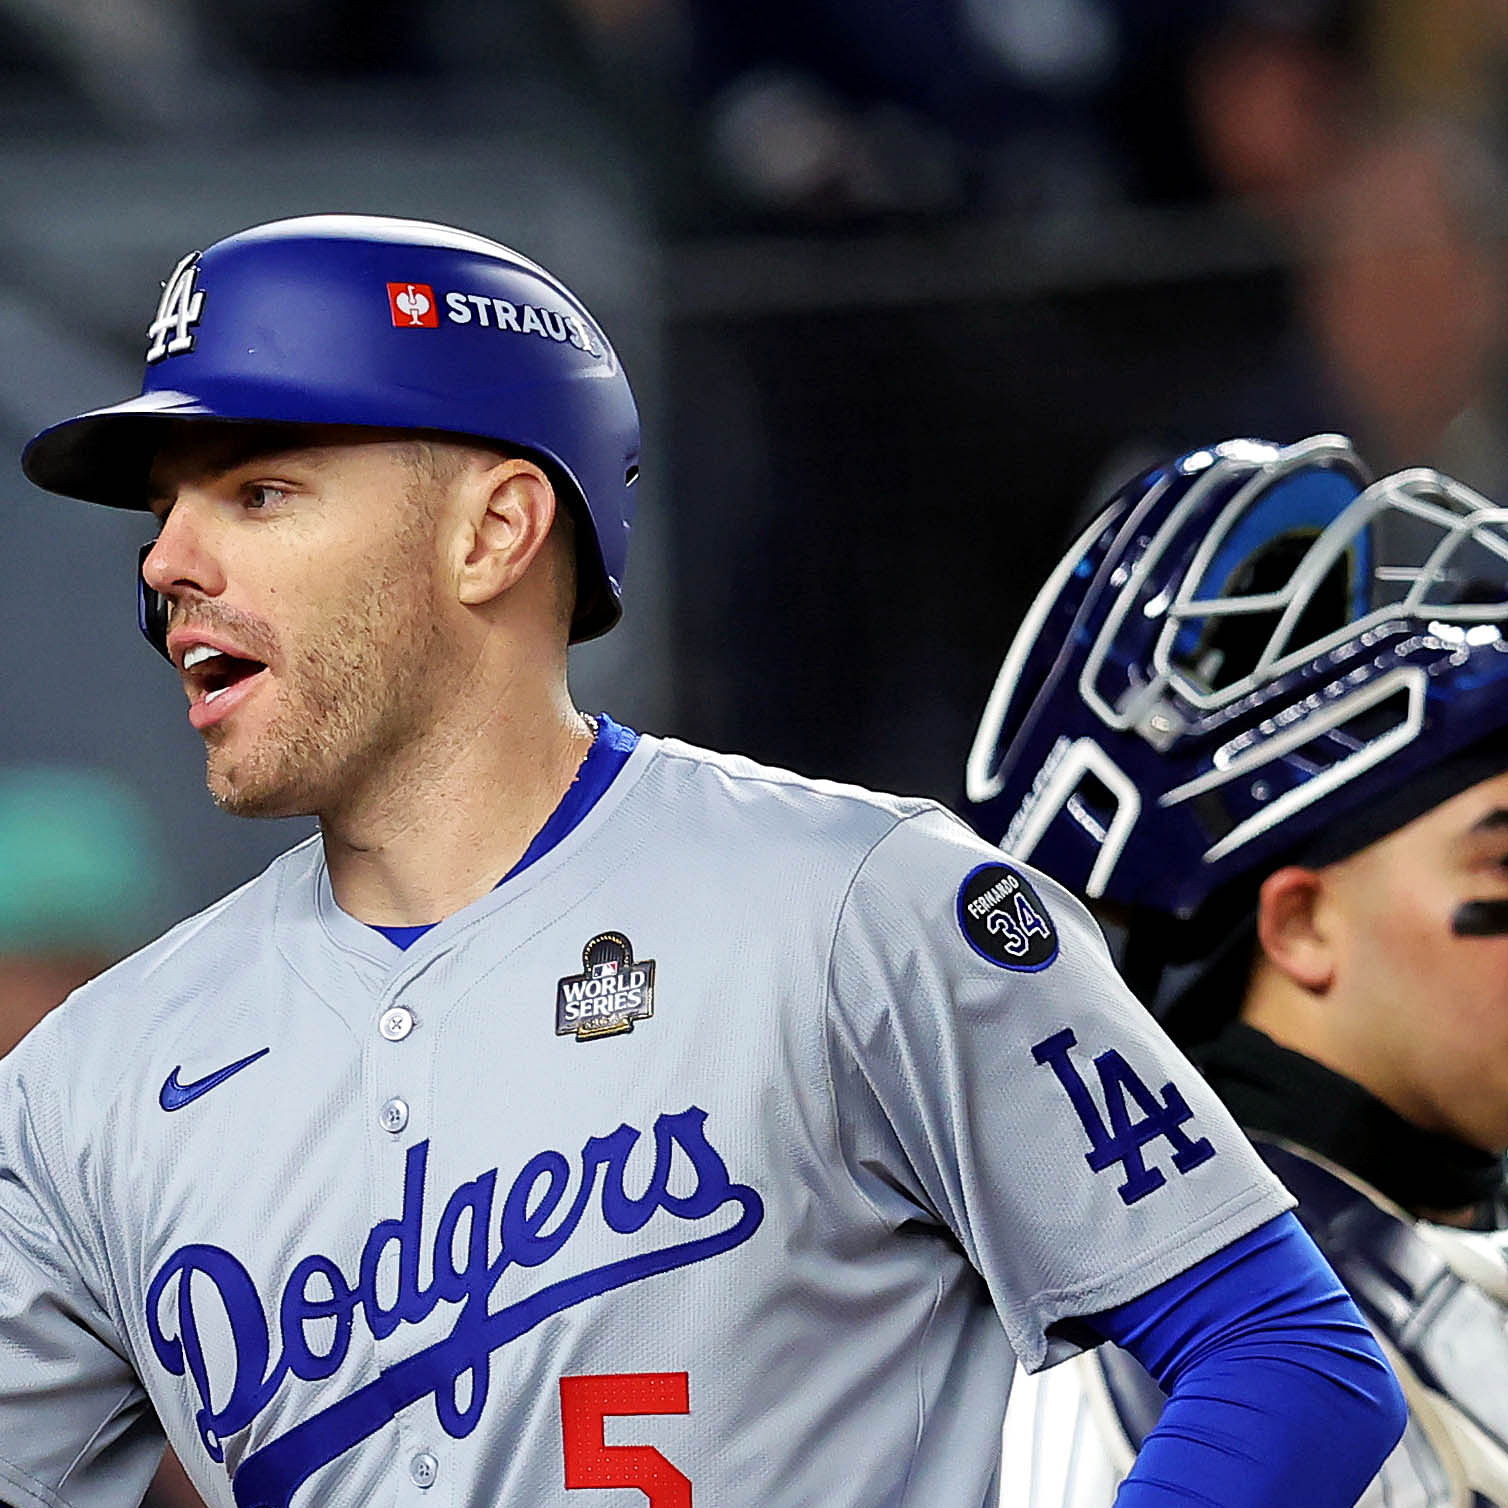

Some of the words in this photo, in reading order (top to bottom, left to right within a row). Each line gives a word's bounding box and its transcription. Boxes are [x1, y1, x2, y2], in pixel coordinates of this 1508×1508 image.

[146, 251, 206, 363] LA
[967, 873, 1020, 920] FERNANDO
[986, 891, 1051, 957] 34
[562, 970, 646, 1004] WORLD
[564, 988, 642, 1021] SERIES
[1030, 1027, 1217, 1207] LA
[145, 1105, 764, 1466] Dodgers
